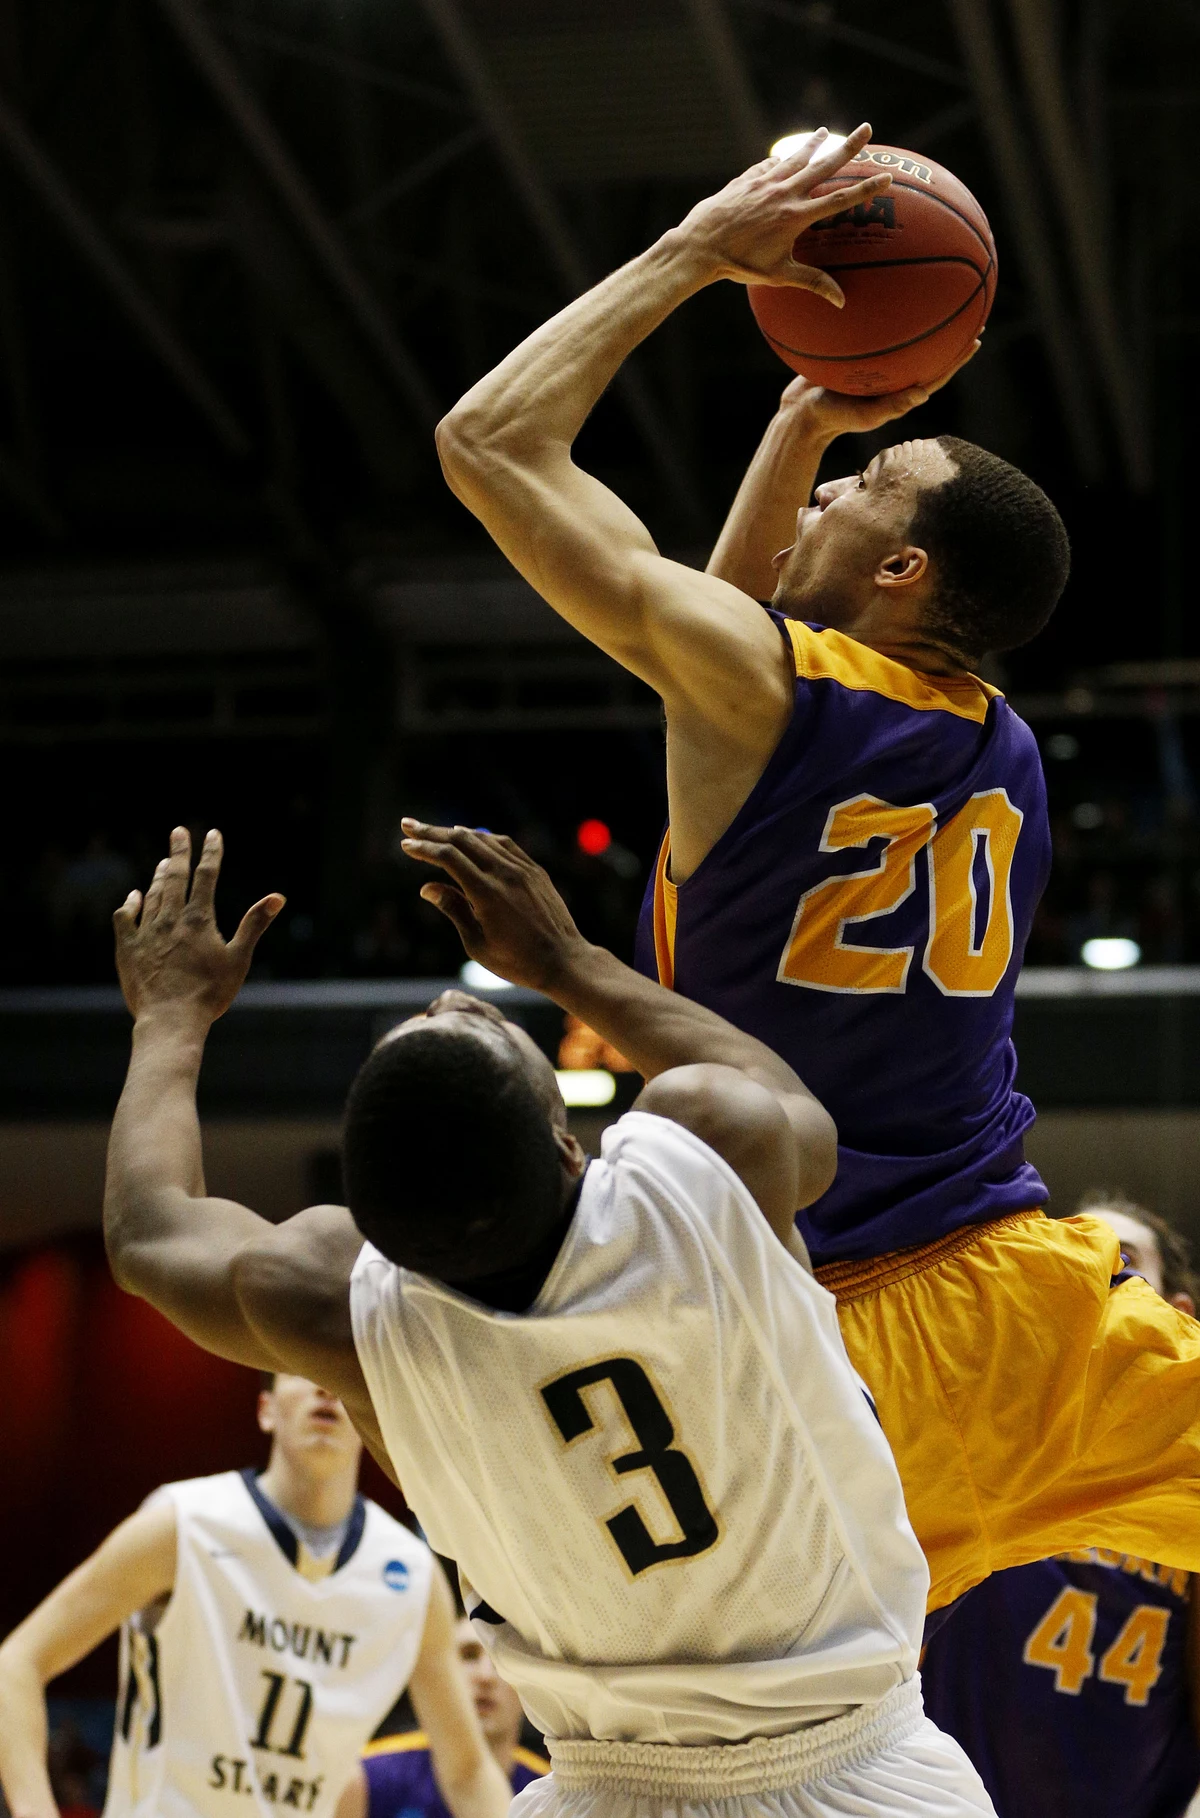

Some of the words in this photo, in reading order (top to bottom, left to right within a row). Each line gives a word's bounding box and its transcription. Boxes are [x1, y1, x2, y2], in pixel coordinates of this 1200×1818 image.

[776, 787, 1024, 997] 20
[536, 1349, 726, 1584] 3
[239, 1608, 355, 1668] MOUNT
[1023, 1585, 1172, 1707] 44
[249, 1670, 314, 1760] 11
[209, 1754, 253, 1794] ST.
[260, 1771, 324, 1813] ARY
